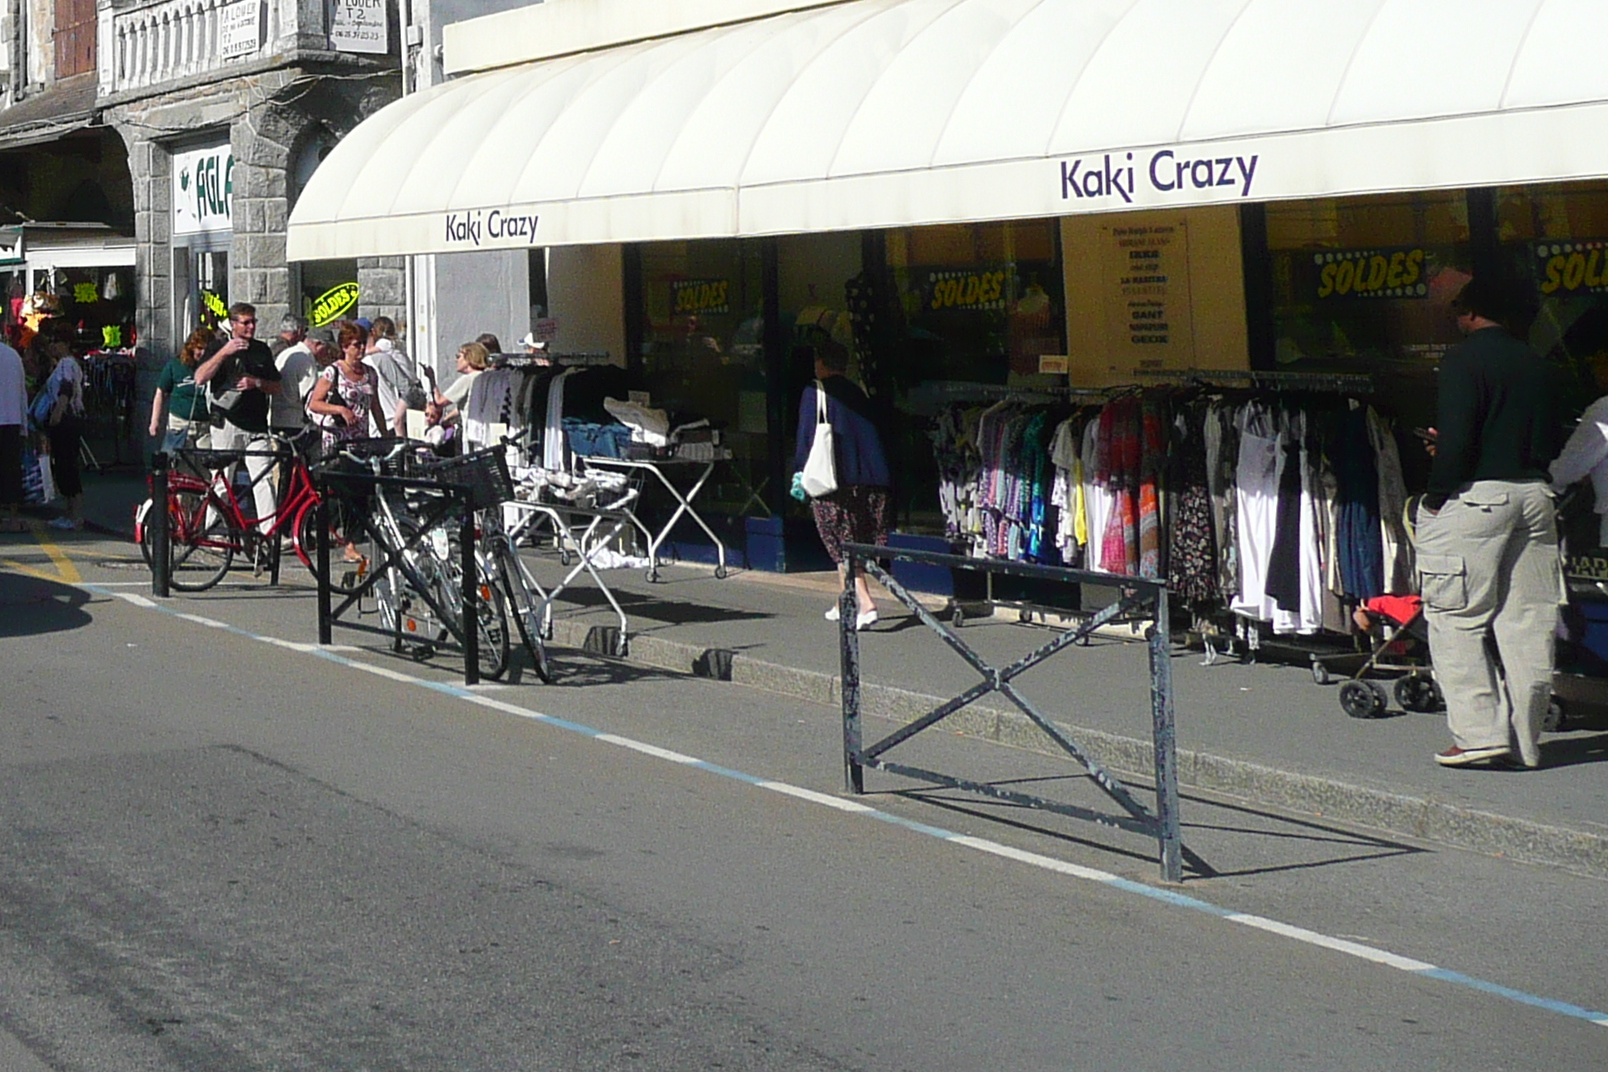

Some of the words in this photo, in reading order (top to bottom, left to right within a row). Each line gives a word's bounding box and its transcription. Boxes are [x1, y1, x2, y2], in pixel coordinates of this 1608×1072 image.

[1061, 151, 1134, 204] Kaki
[1148, 149, 1260, 198] Crazy
[445, 209, 481, 246] Kaki
[487, 209, 539, 245] Crazy
[931, 270, 1005, 310] SOLDES
[1316, 248, 1424, 298] SOLDES
[313, 285, 353, 324] SOLDES
[675, 280, 729, 311] SOLDES
[1131, 310, 1164, 319] GANT
[1130, 334, 1169, 344] GEOX
